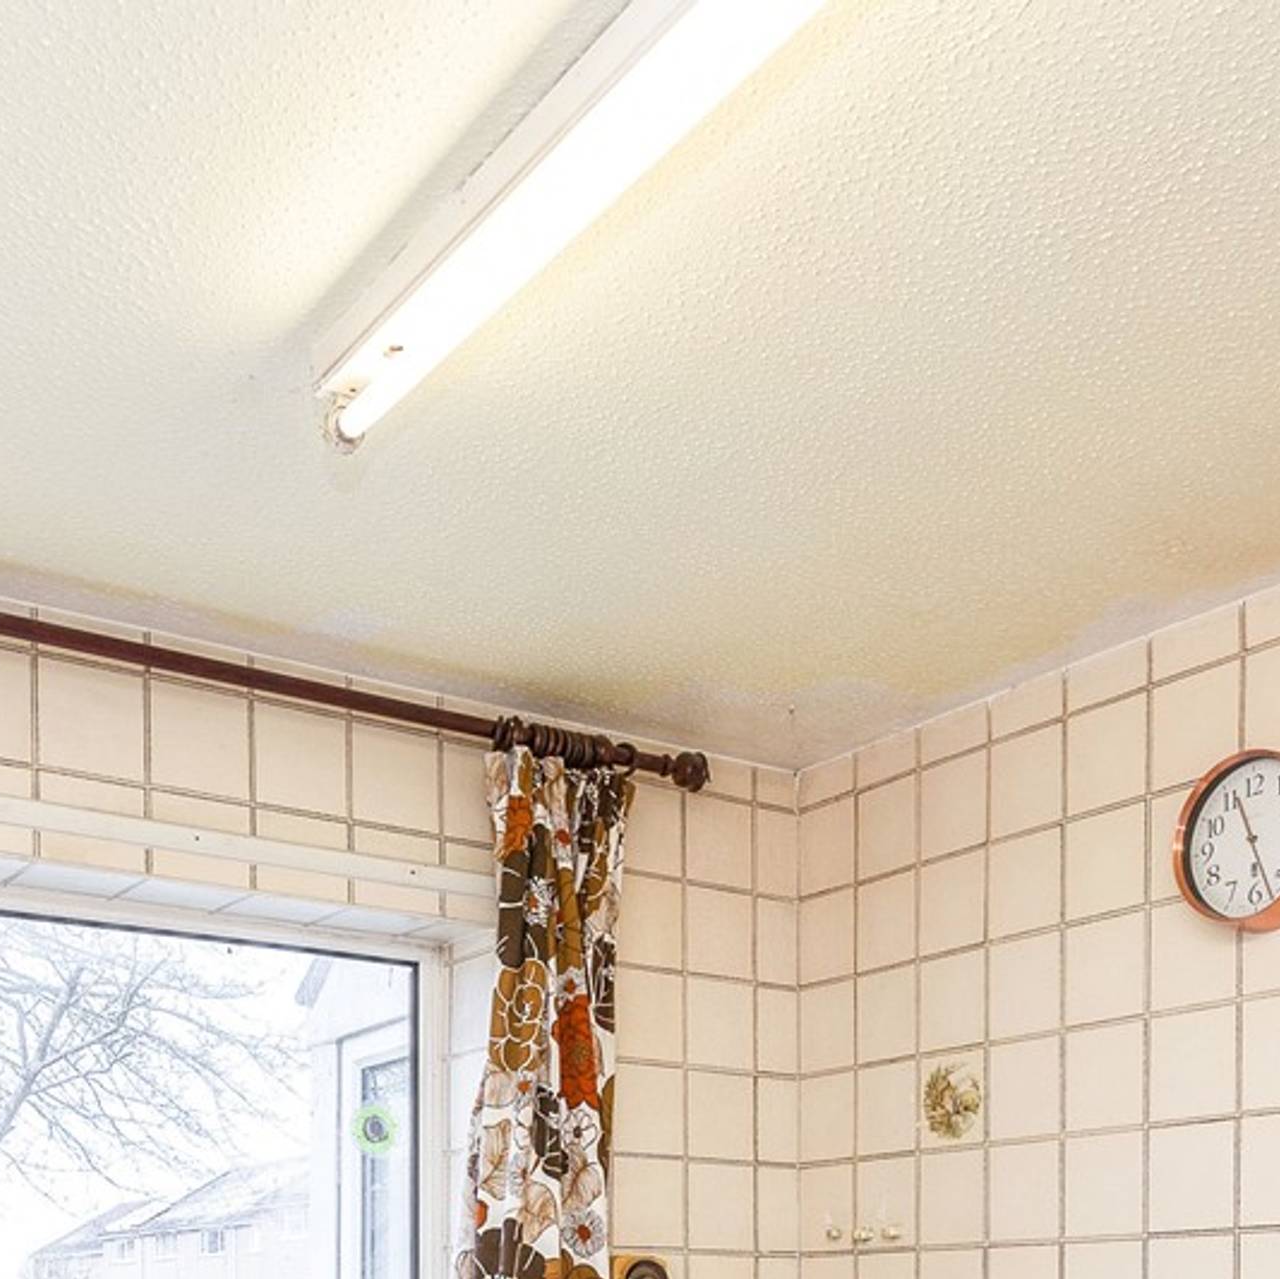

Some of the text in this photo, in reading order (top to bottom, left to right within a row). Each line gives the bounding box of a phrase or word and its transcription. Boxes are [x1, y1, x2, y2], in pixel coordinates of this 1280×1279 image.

[1245, 773, 1265, 799] 12
[1223, 789, 1239, 812] 11
[1208, 816, 1225, 838] 10
[1201, 842, 1215, 864] 9
[1206, 865, 1220, 886] 8
[1225, 881, 1238, 905] 7
[1247, 882, 1263, 905] 6
